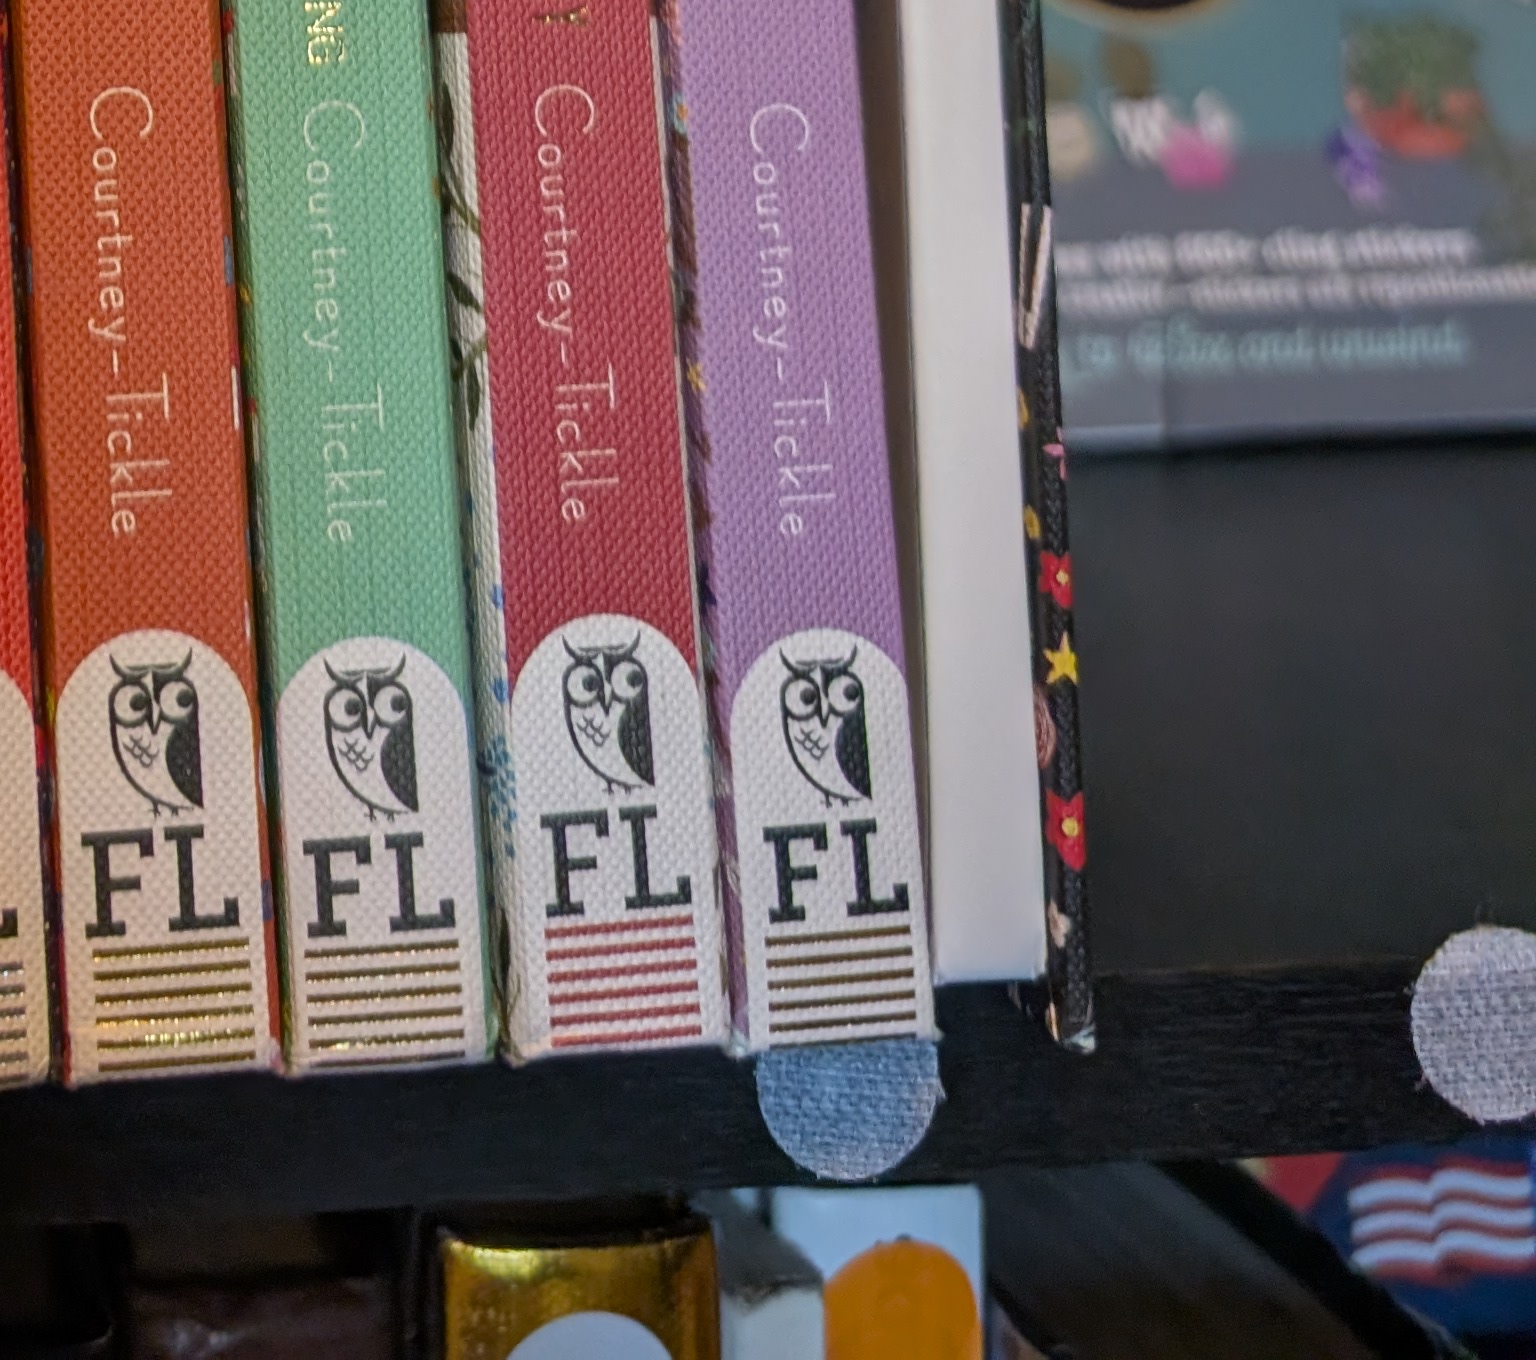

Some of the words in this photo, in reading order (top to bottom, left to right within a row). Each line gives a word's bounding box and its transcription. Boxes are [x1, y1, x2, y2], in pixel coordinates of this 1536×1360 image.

[87, 85, 173, 537] Courtney-Tickle
[302, 99, 388, 542] Courtney-Tickle
[534, 83, 620, 525] Courtney-Tickle
[749, 102, 838, 538] Courtney-Tickle
[80, 823, 240, 939] FL
[302, 831, 456, 940] FL
[539, 803, 693, 920] FL
[762, 817, 909, 925] FL
